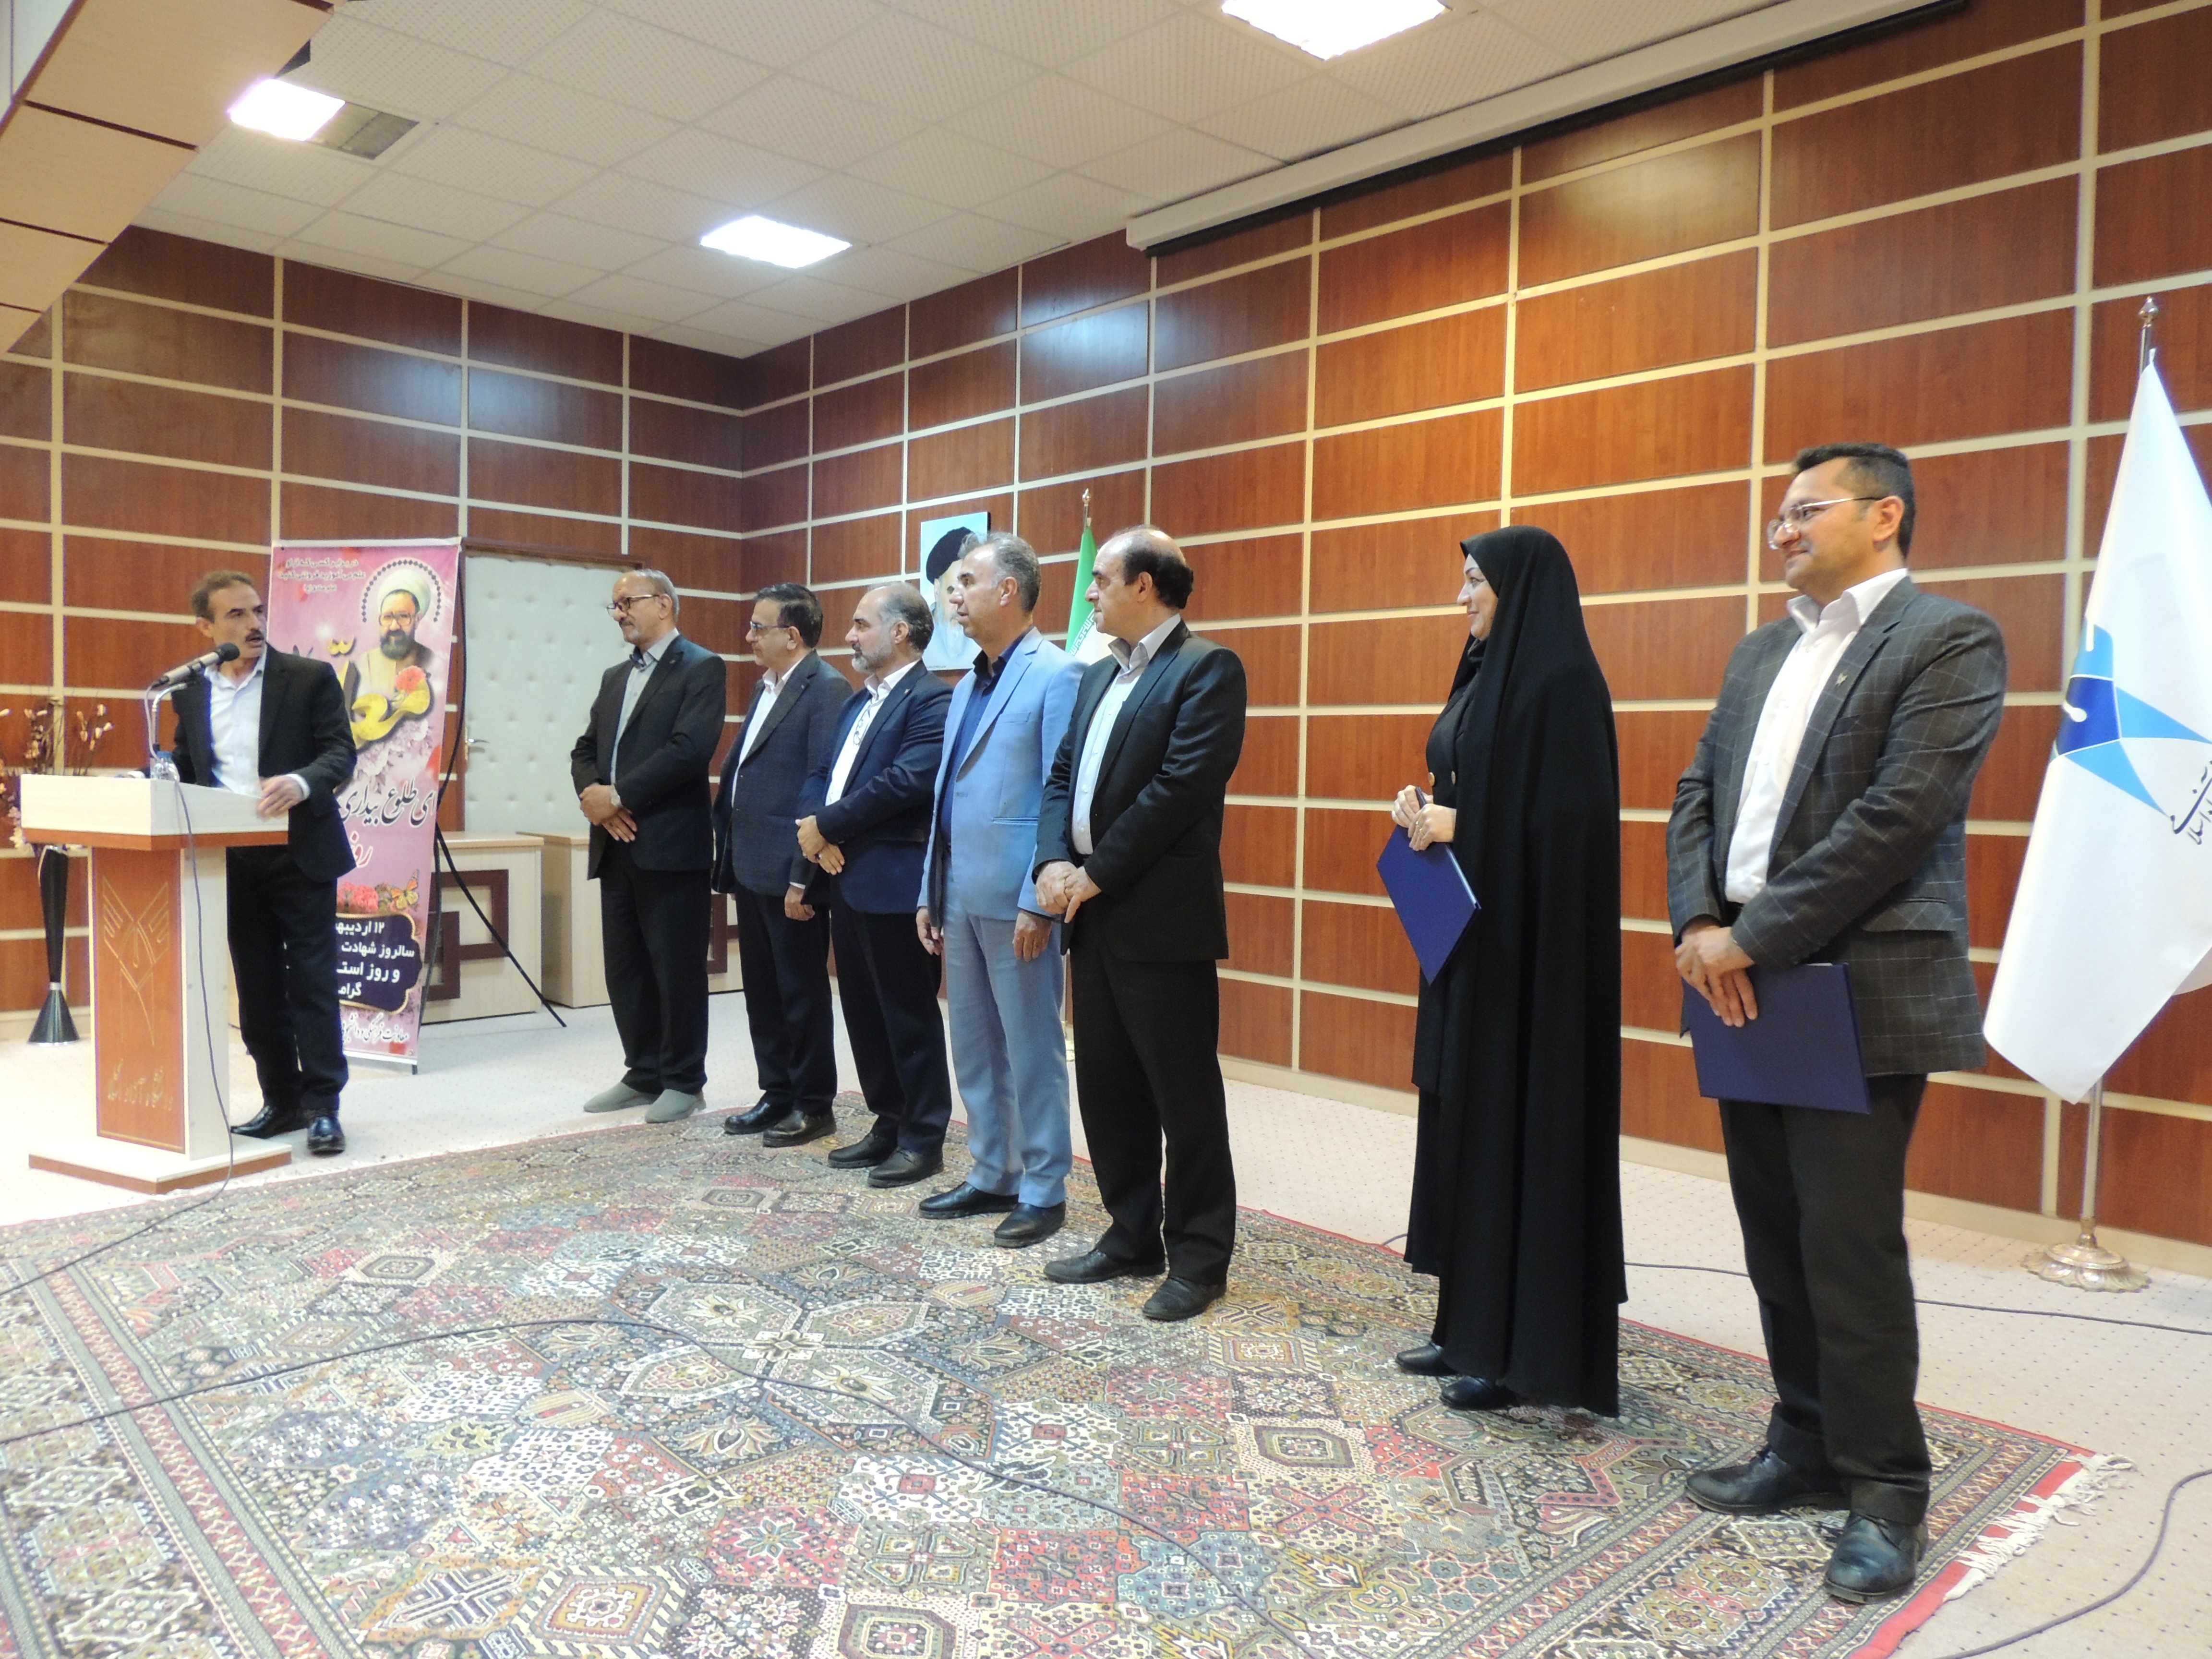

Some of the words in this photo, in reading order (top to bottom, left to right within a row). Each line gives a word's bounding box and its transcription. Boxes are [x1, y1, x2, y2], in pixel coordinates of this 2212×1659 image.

[381, 777, 418, 825] طلوع
[409, 792, 436, 827] ای
[341, 941, 376, 957] شهادت
[378, 944, 415, 960] سالروز
[366, 963, 389, 982] روز
[391, 969, 400, 983] و
[337, 982, 362, 999] گرام
